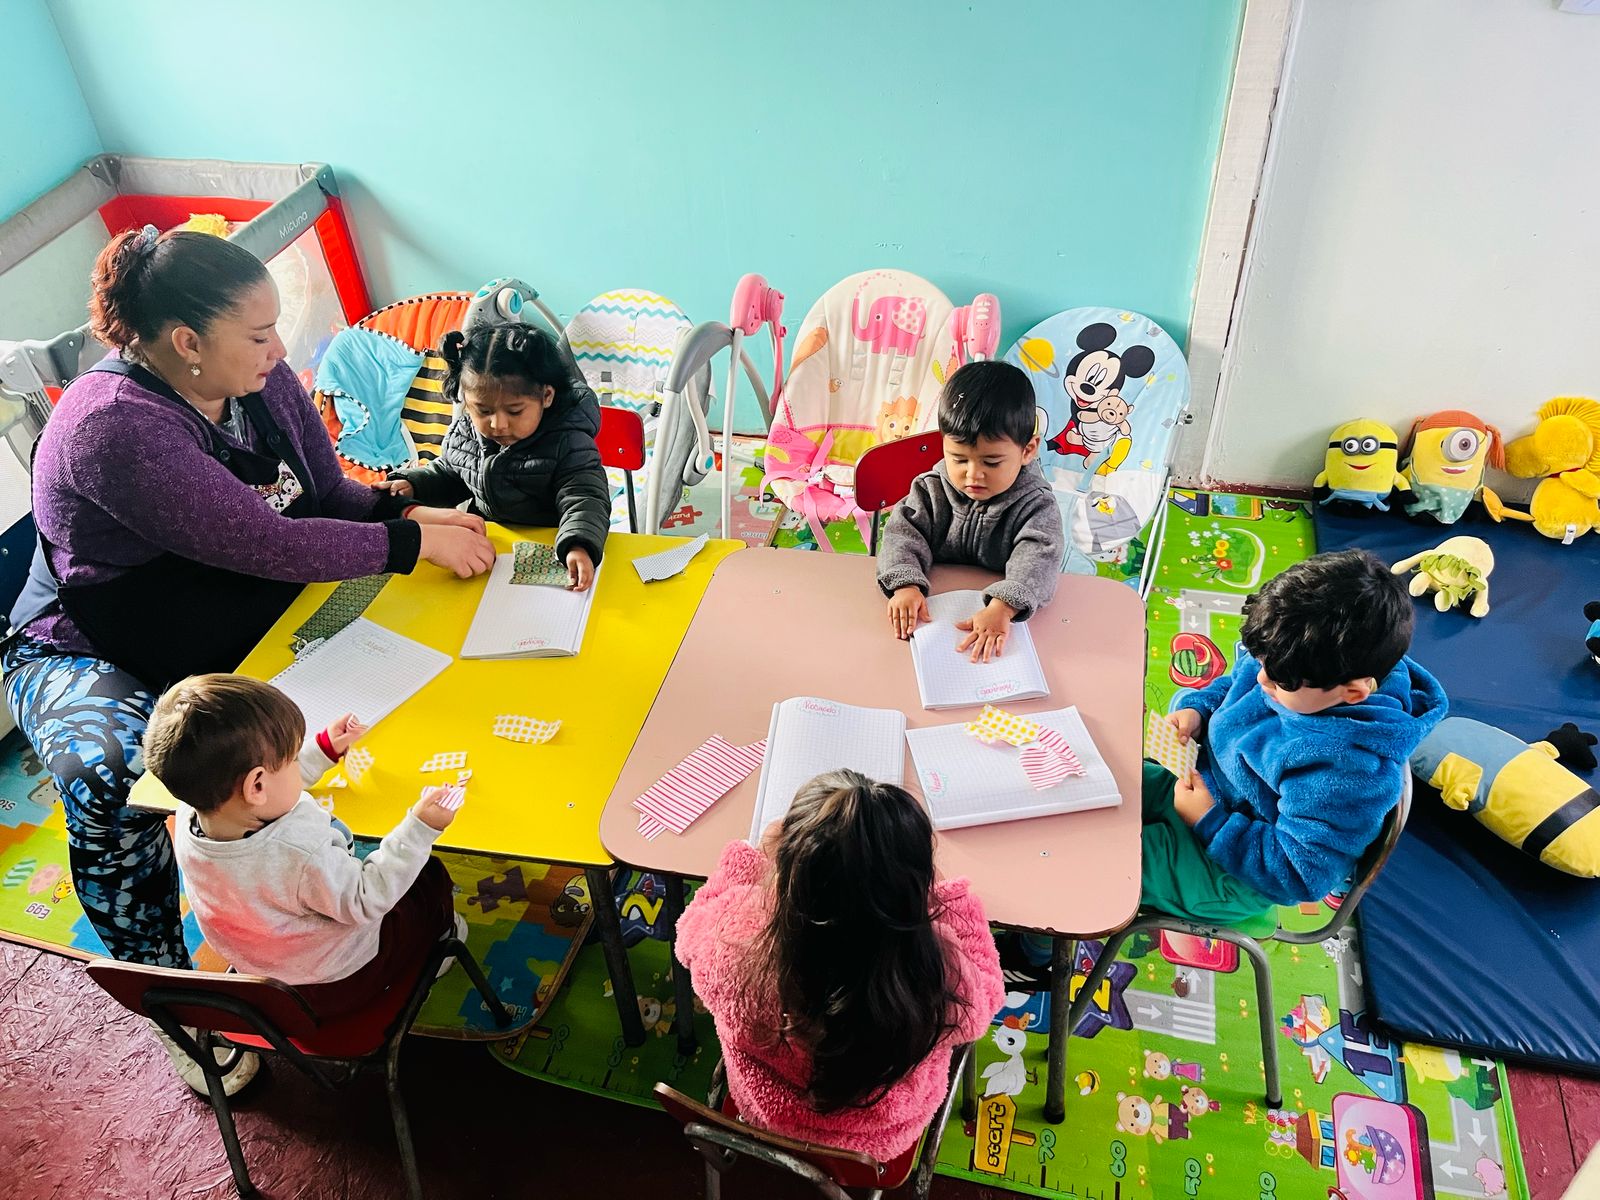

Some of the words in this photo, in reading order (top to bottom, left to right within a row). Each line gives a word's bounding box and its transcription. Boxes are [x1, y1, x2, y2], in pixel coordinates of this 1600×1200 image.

[279, 211, 308, 239] Micuna
[667, 513, 691, 521] Puzzl
[26, 903, 50, 919] Egg
[987, 1101, 1006, 1167] start
[1038, 1129, 1057, 1165] 70
[1110, 1140, 1127, 1178] 60
[1184, 1158, 1202, 1196] 50
